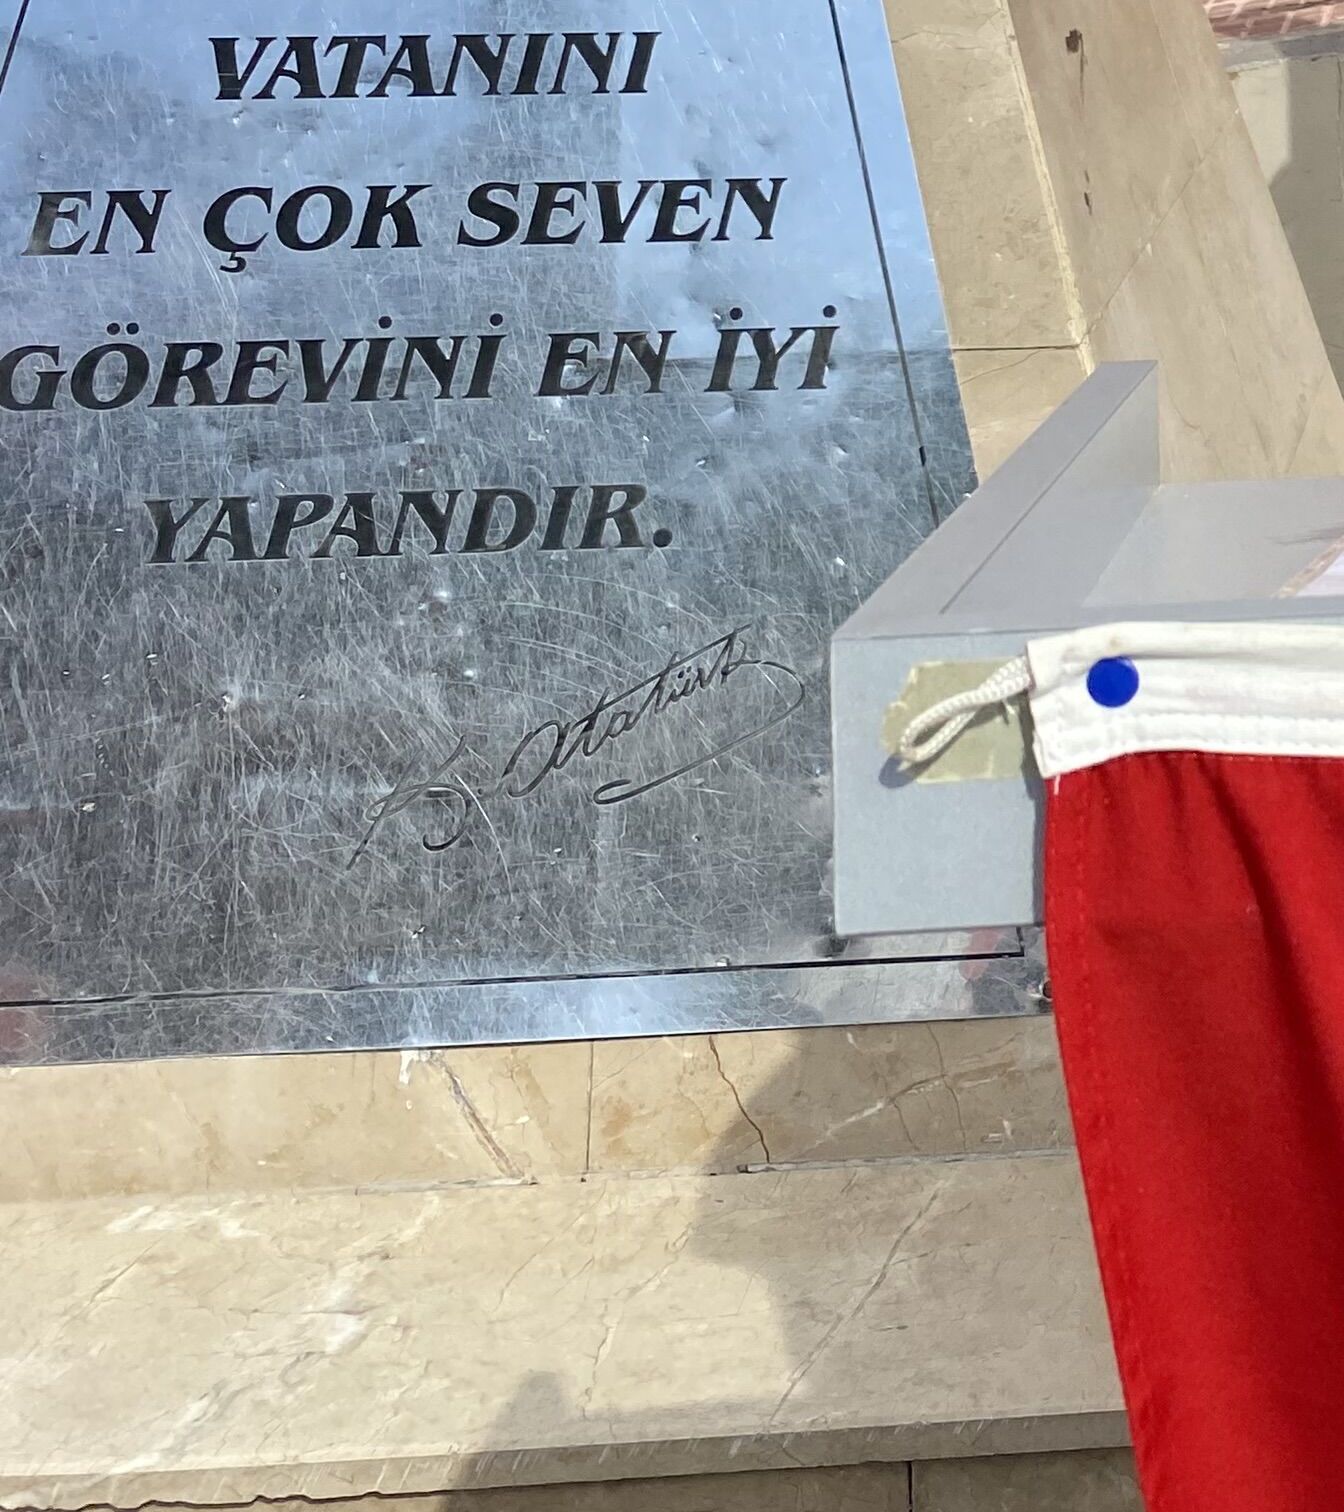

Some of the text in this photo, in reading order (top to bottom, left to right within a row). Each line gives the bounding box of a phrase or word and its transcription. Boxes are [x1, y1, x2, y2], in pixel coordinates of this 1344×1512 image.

[208, 32, 662, 100] VATANINI
[21, 178, 788, 273] EN ÇOK SEVEN
[0, 305, 841, 412] GÖREVİNİ EN İYİ
[143, 484, 673, 565] YAPANDIR.
